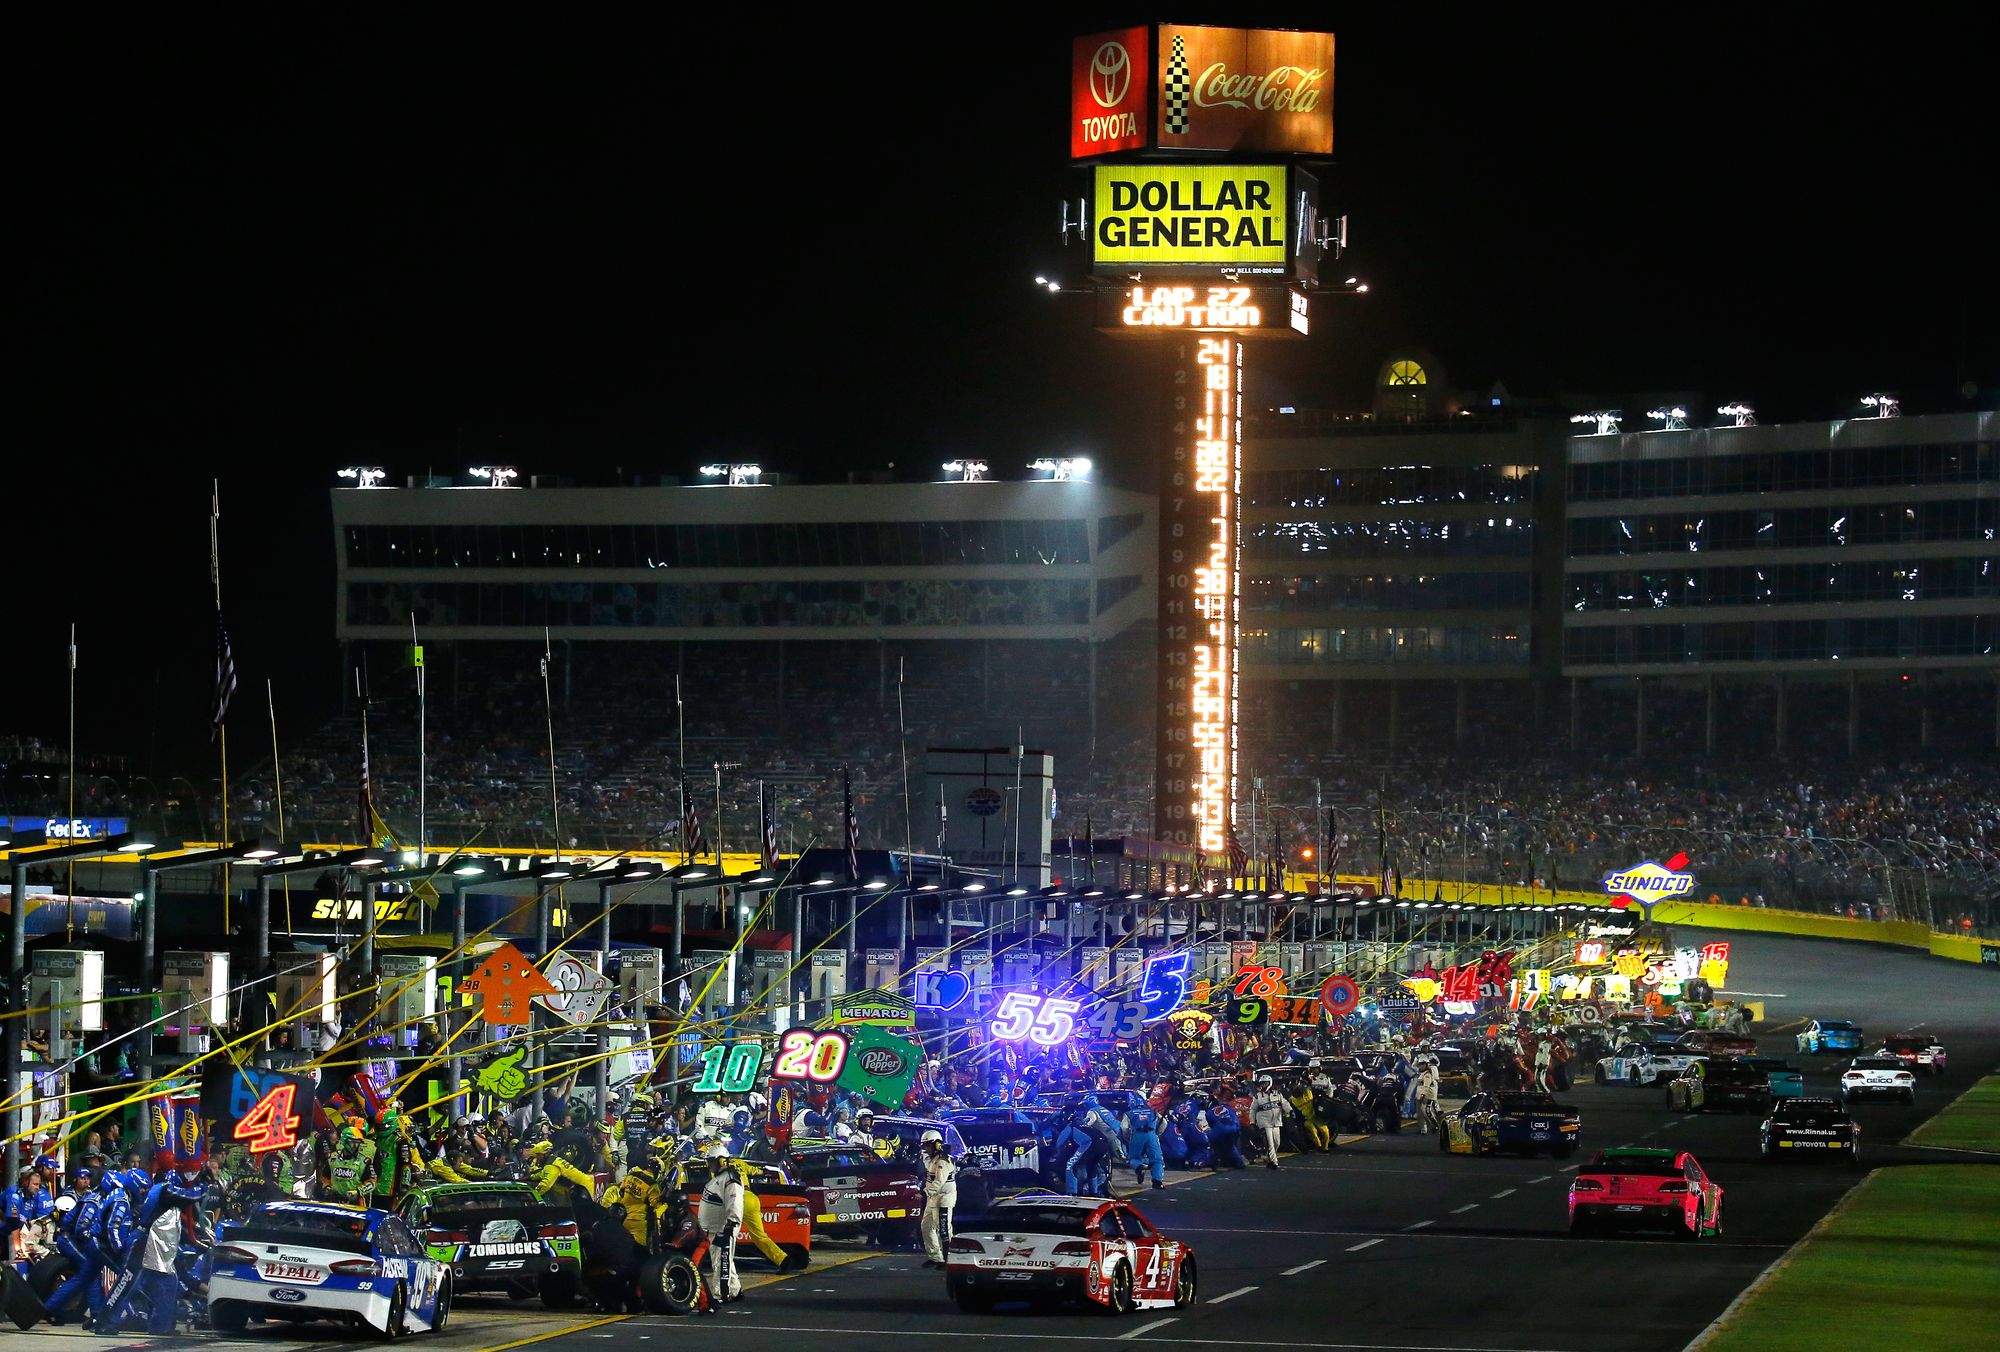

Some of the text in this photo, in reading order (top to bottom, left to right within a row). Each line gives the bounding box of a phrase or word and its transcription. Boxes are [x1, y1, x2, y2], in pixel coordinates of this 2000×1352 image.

[1193, 62, 1328, 113] Coca-Cola
[1082, 112, 1137, 143] TOYOTA
[1110, 180, 1271, 212] DOLLAR
[1099, 216, 1284, 248] GENERAL
[1133, 287, 1251, 307] LAP 27
[1123, 306, 1260, 327] CAUTION
[1179, 339, 1229, 364] 1 24
[1175, 364, 1229, 390] 2 18
[1175, 390, 1229, 415] 3 11
[1174, 415, 1229, 441] 4 41
[1174, 448, 1185, 461] 5
[1174, 466, 1227, 491] 6 22
[1174, 492, 1228, 517] 7 1
[1173, 517, 1227, 543] 8 7
[1173, 543, 1227, 568] 9 2
[1168, 568, 1227, 594] 10 38
[1167, 601, 1184, 614] 11
[1166, 620, 1225, 645] 12 4
[1166, 645, 1225, 671] 13 31
[1166, 671, 1225, 696] 14 27
[1166, 703, 1187, 717] 15
[1166, 723, 1225, 748] 16 55
[1165, 748, 1223, 773] 17 10
[1165, 779, 1185, 793] 18
[1164, 805, 1185, 819] 19
[46, 820, 92, 838] FedEx
[1163, 831, 1187, 844] 20
[1611, 876, 1689, 891] SUNOCO
[464, 980, 480, 991] 98
[918, 975, 942, 1005] K
[1141, 952, 1189, 1023] 5
[1234, 966, 1284, 997] 78
[1437, 965, 1478, 1003] 14
[1528, 972, 1538, 991] 1
[841, 1008, 908, 1018] MENARDS
[1238, 1002, 1260, 1023] 9
[1280, 998, 1312, 1024] 34
[1382, 998, 1415, 1007] LOWE'S
[991, 992, 1081, 1045] 55
[1088, 1000, 1149, 1039] 43
[1168, 1010, 1215, 1023] THUNDER
[1176, 1040, 1202, 1049] COAL
[775, 1031, 847, 1081] 20
[866, 1052, 899, 1071] Pepper
[876, 1051, 891, 1062] Dr
[692, 1044, 763, 1092] 10
[779, 1088, 789, 1123] SUNOCO
[151, 1105, 165, 1146] SUNOCO
[234, 1084, 301, 1153] 4
[185, 1109, 194, 1154] SUNOCO
[1566, 1133, 1576, 1141] 34
[974, 1145, 998, 1154] LOVE
[1014, 1147, 1025, 1155] 95
[843, 1190, 897, 1200] drpepper.com
[265, 1202, 367, 1219] FASTENAL
[850, 1211, 885, 1220] TOYOTA
[909, 1208, 921, 1217] 23
[469, 1242, 541, 1257] ZOMBUCKS
[557, 1242, 572, 1250] 98
[279, 1254, 309, 1264] FASTENAL
[381, 1257, 409, 1279] FASTENAL
[485, 1259, 526, 1270] SS
[1027, 1260, 1056, 1268] BUDS
[1145, 1243, 1160, 1289] 4
[264, 1263, 321, 1280] WYPALL
[106, 1269, 134, 1308] FASTENAL
[275, 1289, 301, 1301] Ford
[357, 1281, 373, 1290] 99
[410, 1260, 426, 1310] 99
